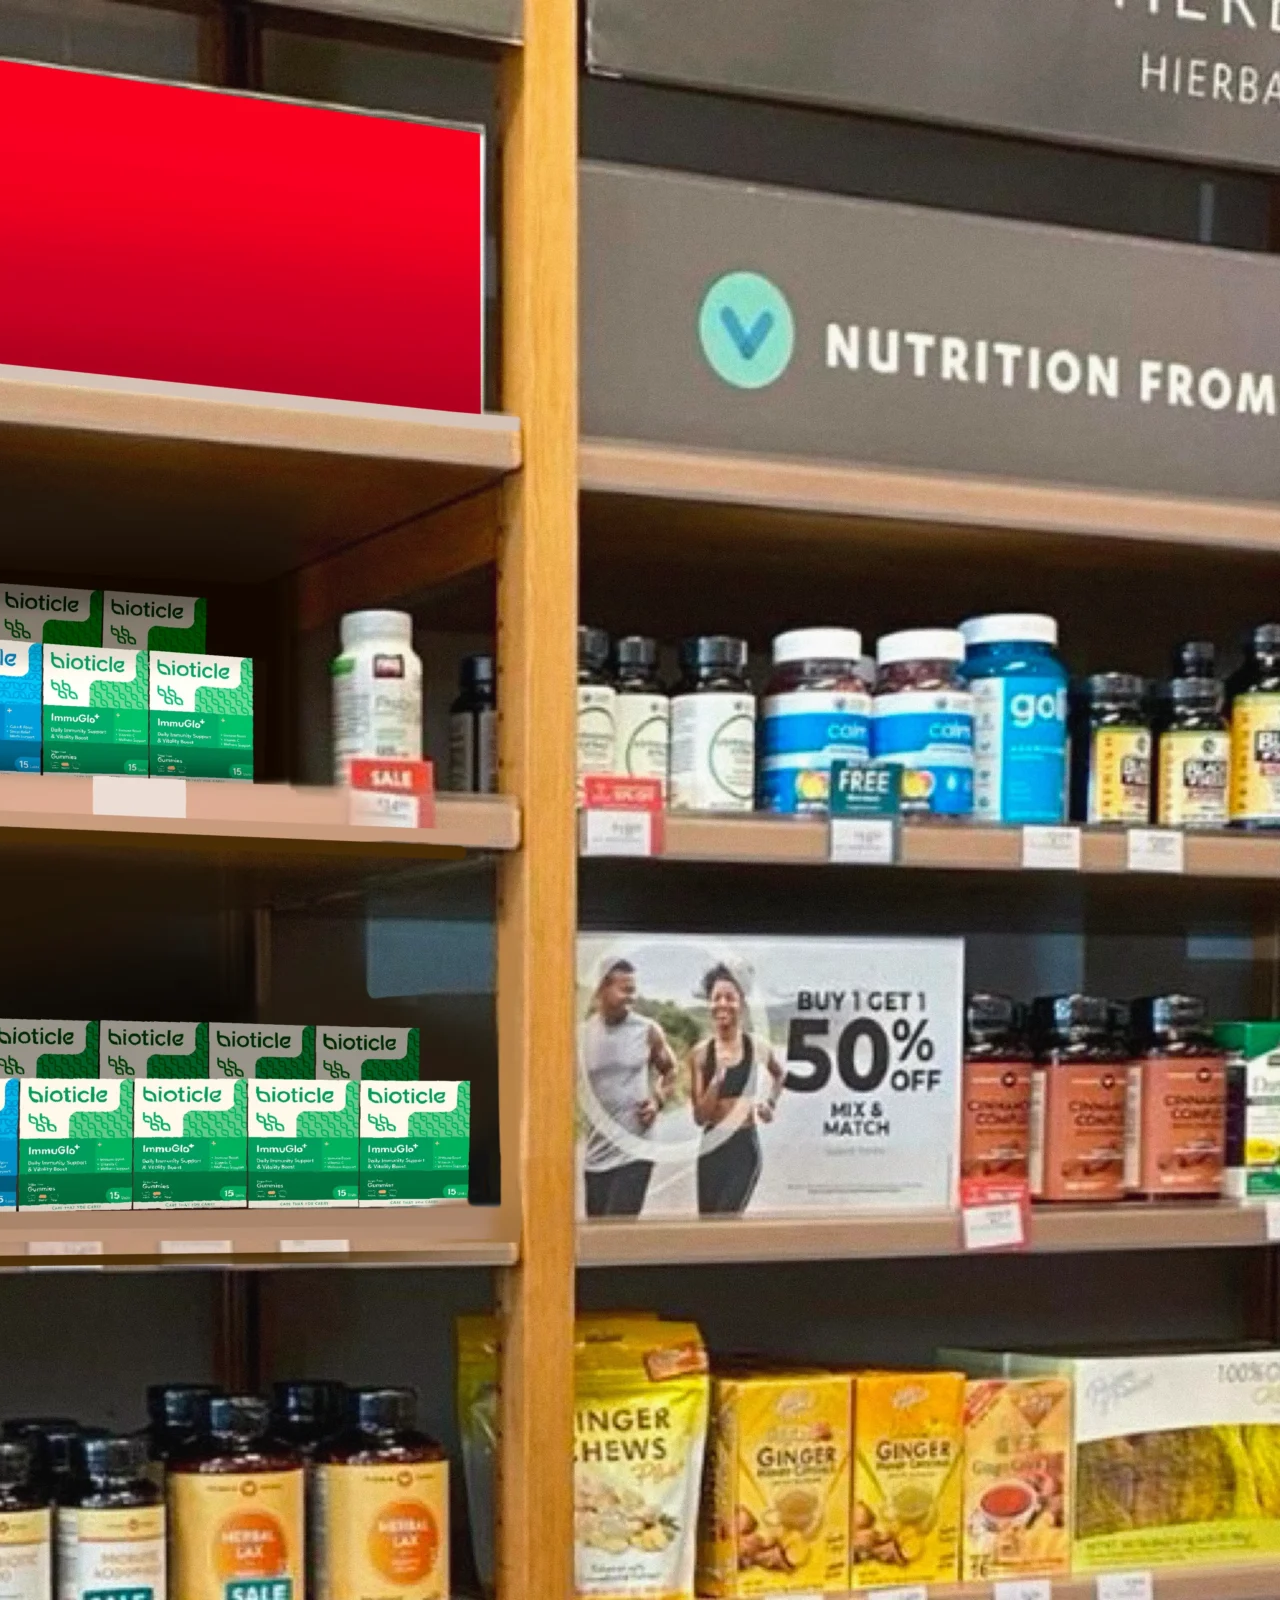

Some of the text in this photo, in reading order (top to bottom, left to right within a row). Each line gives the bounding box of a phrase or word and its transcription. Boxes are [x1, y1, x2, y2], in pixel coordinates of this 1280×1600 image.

[826, 321, 1277, 416] NUTRITION FROM
[5, 592, 79, 613] bioticle
[111, 599, 184, 620] bioticle
[50, 652, 125, 674] bioticle
[157, 659, 230, 680] bioticle
[371, 769, 414, 787] SALE
[838, 769, 890, 793] FREE
[797, 990, 926, 1012] BUY 1 GET 1
[108, 1029, 184, 1047] bioticle
[217, 1030, 291, 1049] bioticle
[323, 1033, 396, 1051] bioticle
[890, 1070, 942, 1092] OFF
[28, 1086, 107, 1103] bioticle
[142, 1086, 221, 1103] bioticle
[256, 1086, 334, 1103] bioticle
[368, 1087, 445, 1104] bioticle
[830, 1102, 883, 1118] MIX &
[822, 1121, 891, 1137] MATCH
[109, 1191, 120, 1200] 15
[576, 1407, 671, 1433] INGER
[574, 1438, 667, 1463] HEWS
[756, 1446, 837, 1467] GINGER
[876, 1440, 951, 1461] GINGER
